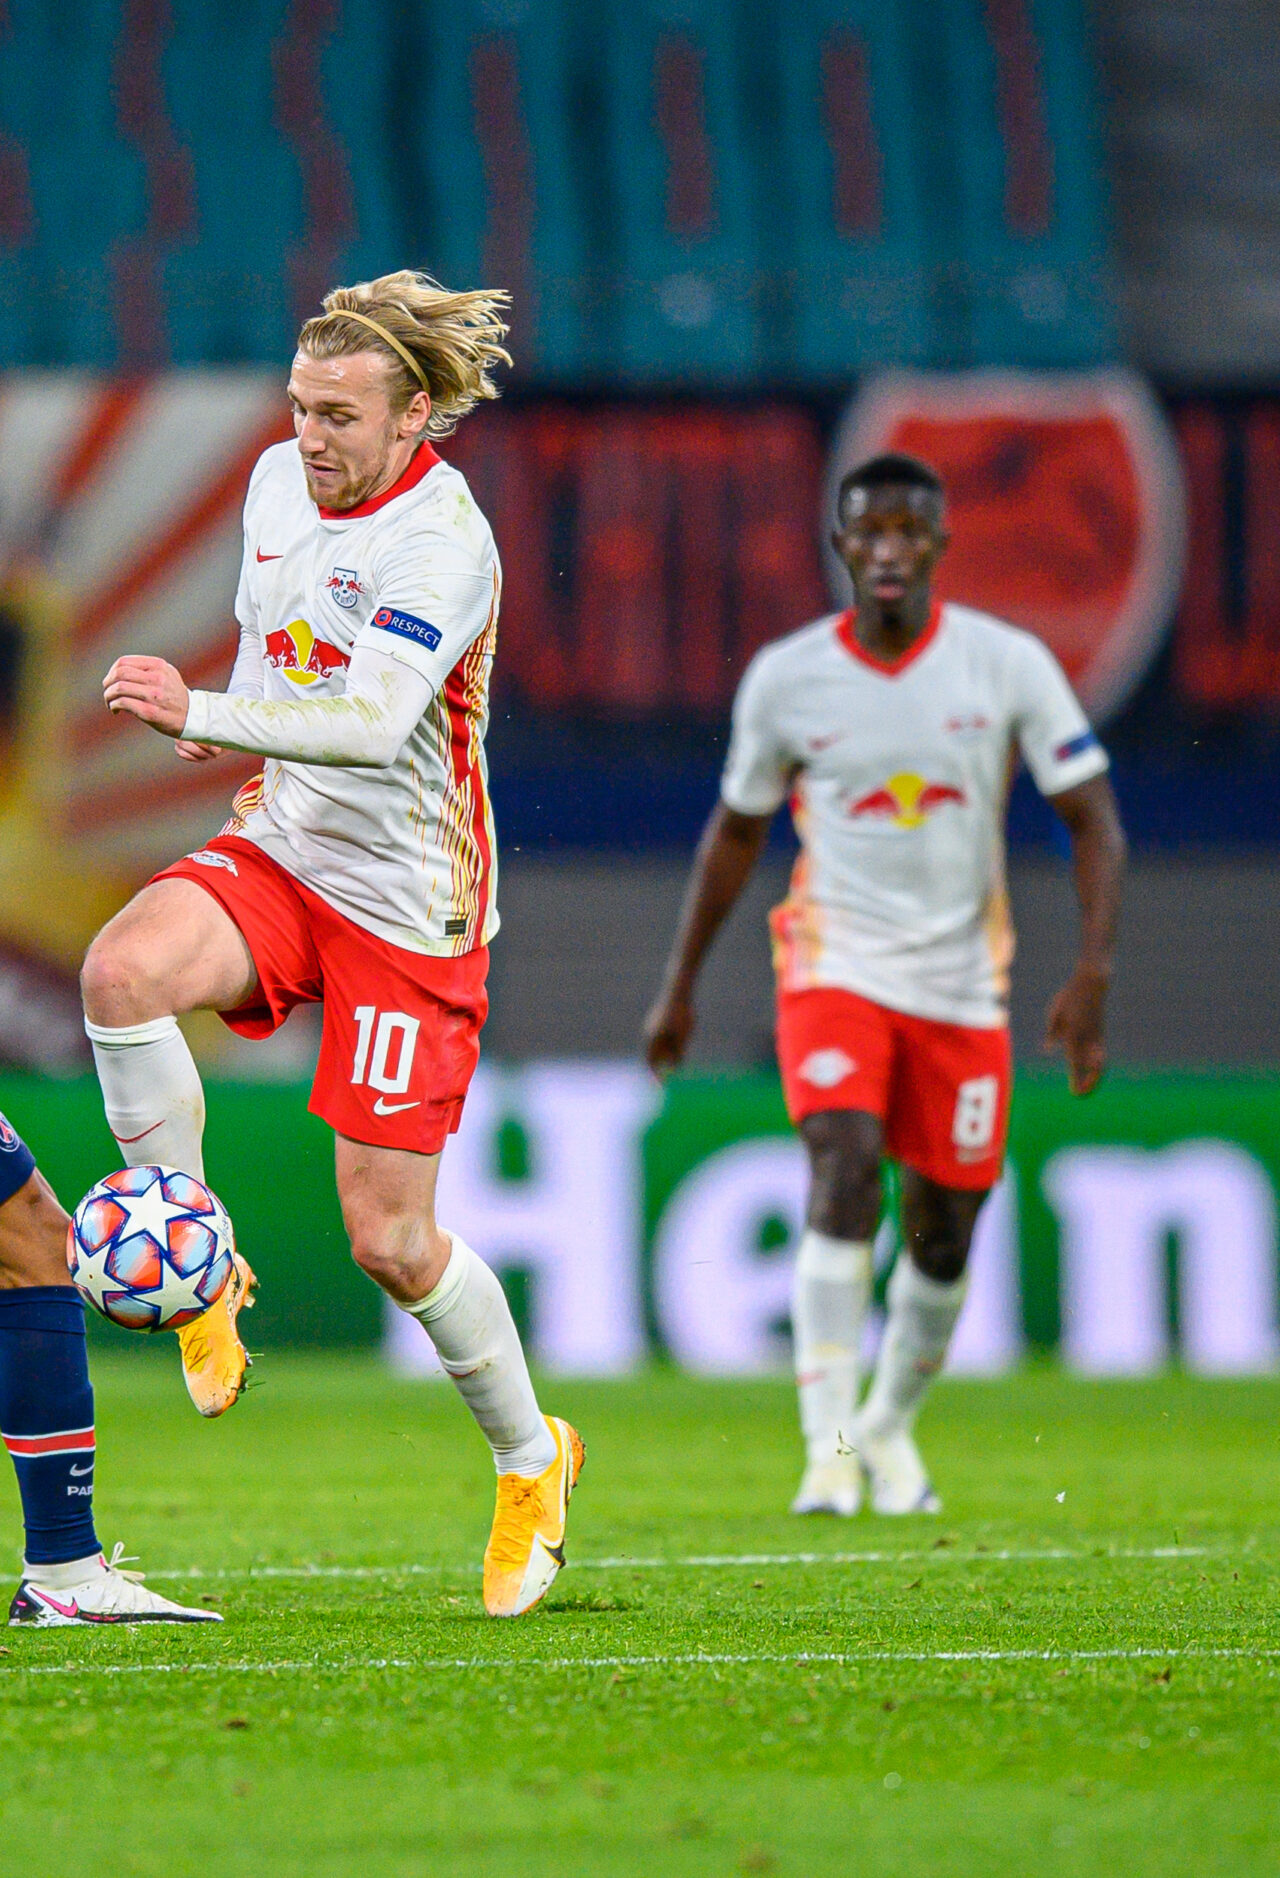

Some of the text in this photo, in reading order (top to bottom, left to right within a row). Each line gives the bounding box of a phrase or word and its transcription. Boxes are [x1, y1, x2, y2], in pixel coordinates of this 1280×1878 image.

[390, 616, 440, 646] RESPECT
[350, 1006, 421, 1094] 10
[951, 1074, 998, 1149] 8
